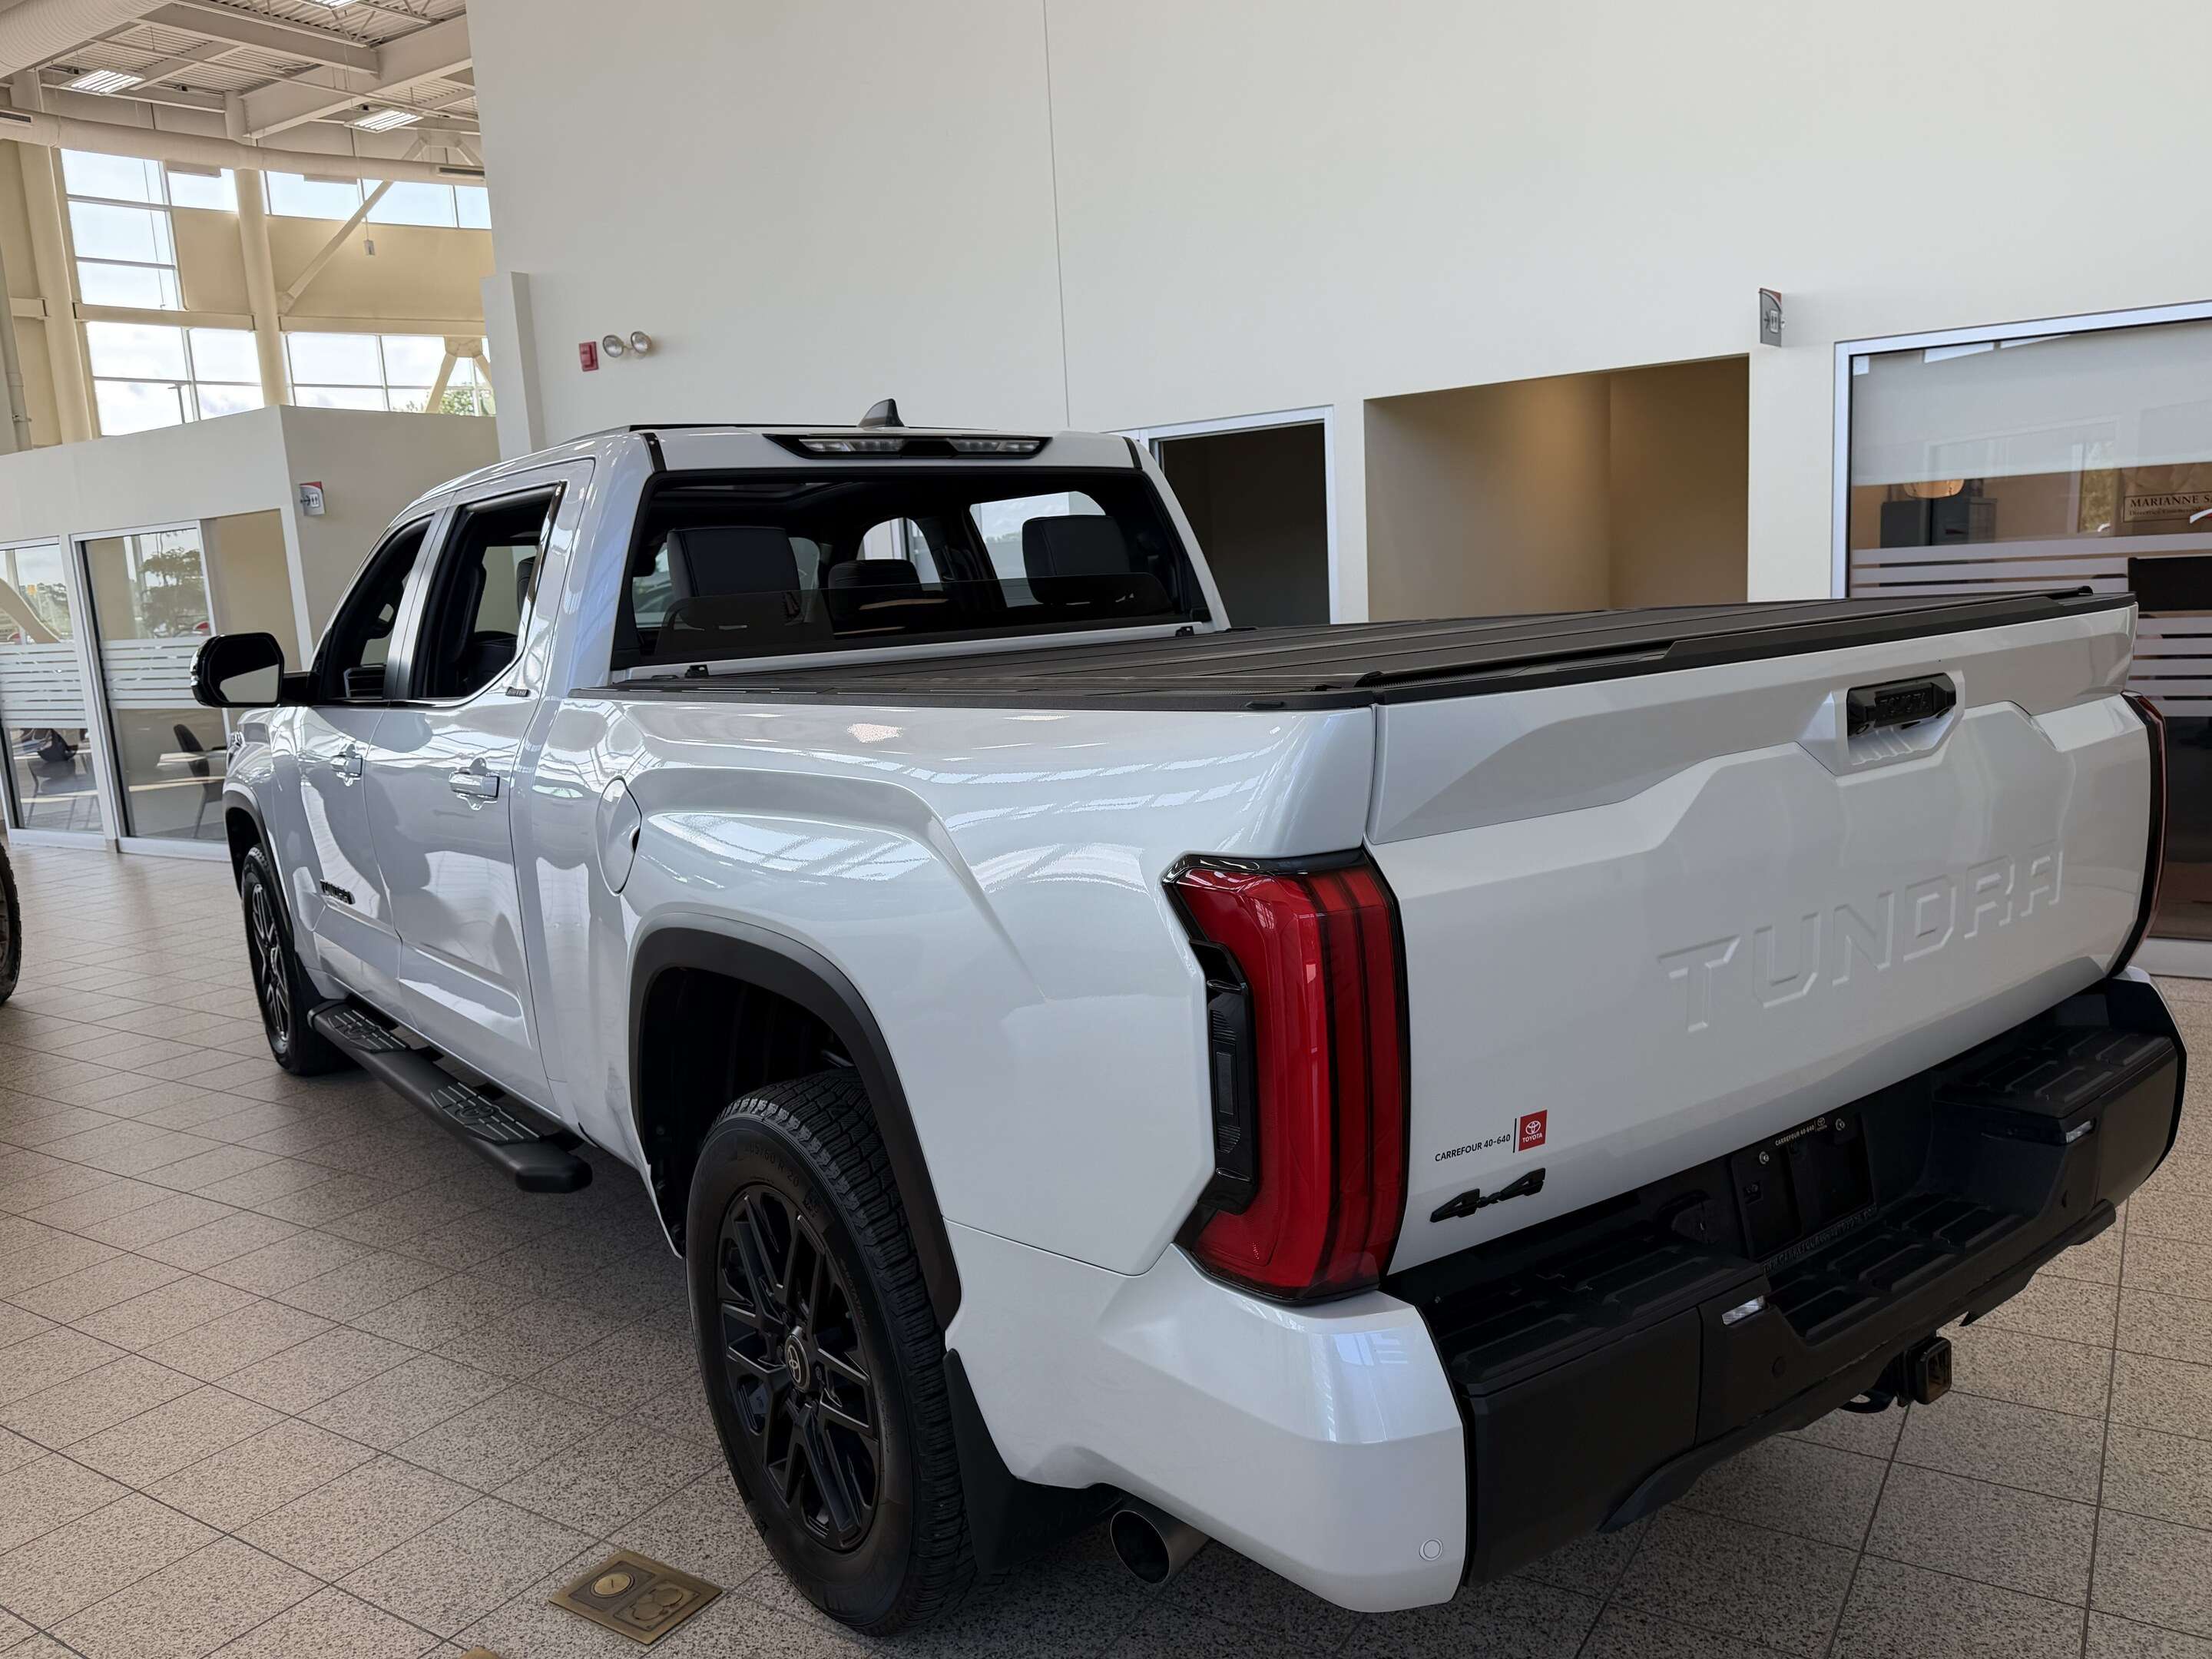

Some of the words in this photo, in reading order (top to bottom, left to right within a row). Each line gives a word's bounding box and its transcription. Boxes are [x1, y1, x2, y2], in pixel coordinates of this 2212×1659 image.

[2130, 495, 2199, 508] MARIANNE
[1657, 839, 2065, 1033] TUNDRA
[1435, 1141, 1482, 1162] CARREFOUR
[1483, 1134, 1511, 1148] 40-640
[1522, 1132, 1543, 1144] TOYOTA
